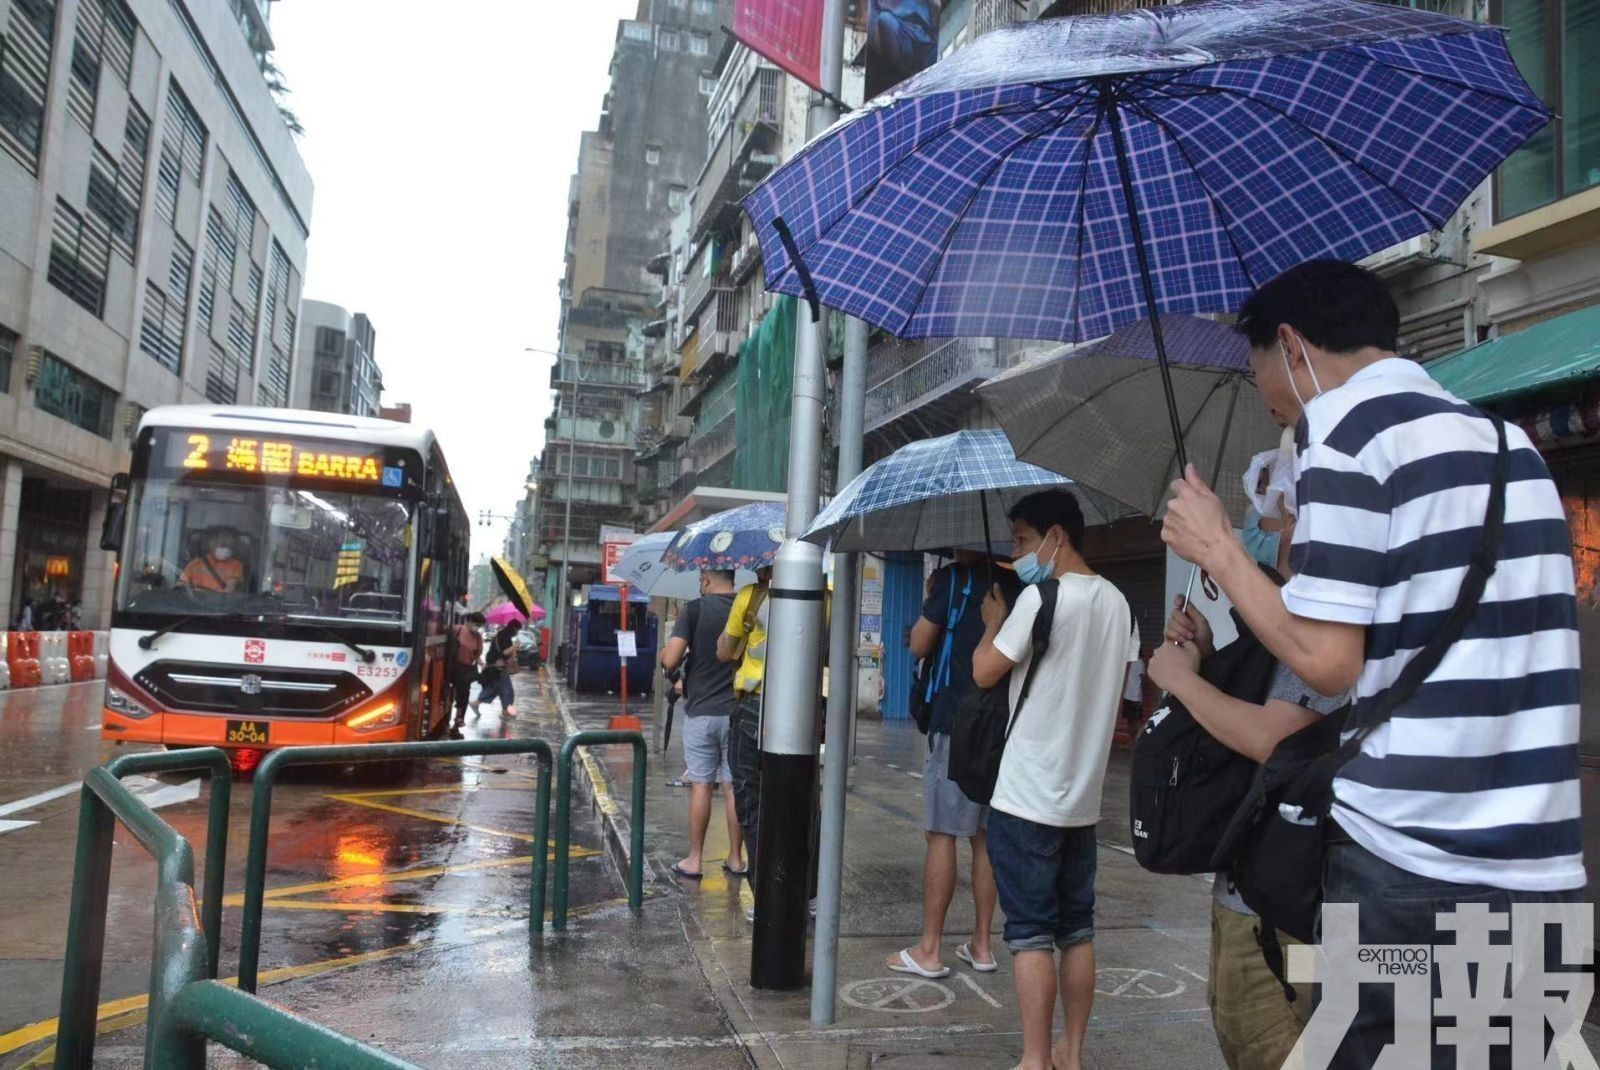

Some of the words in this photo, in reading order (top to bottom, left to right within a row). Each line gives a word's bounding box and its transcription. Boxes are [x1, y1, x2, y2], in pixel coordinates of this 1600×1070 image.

[183, 434, 210, 469] 2
[297, 452, 378, 480] BARRA
[357, 666, 398, 677] E3253
[240, 721, 255, 732] AA
[229, 731, 265, 743] 30-04
